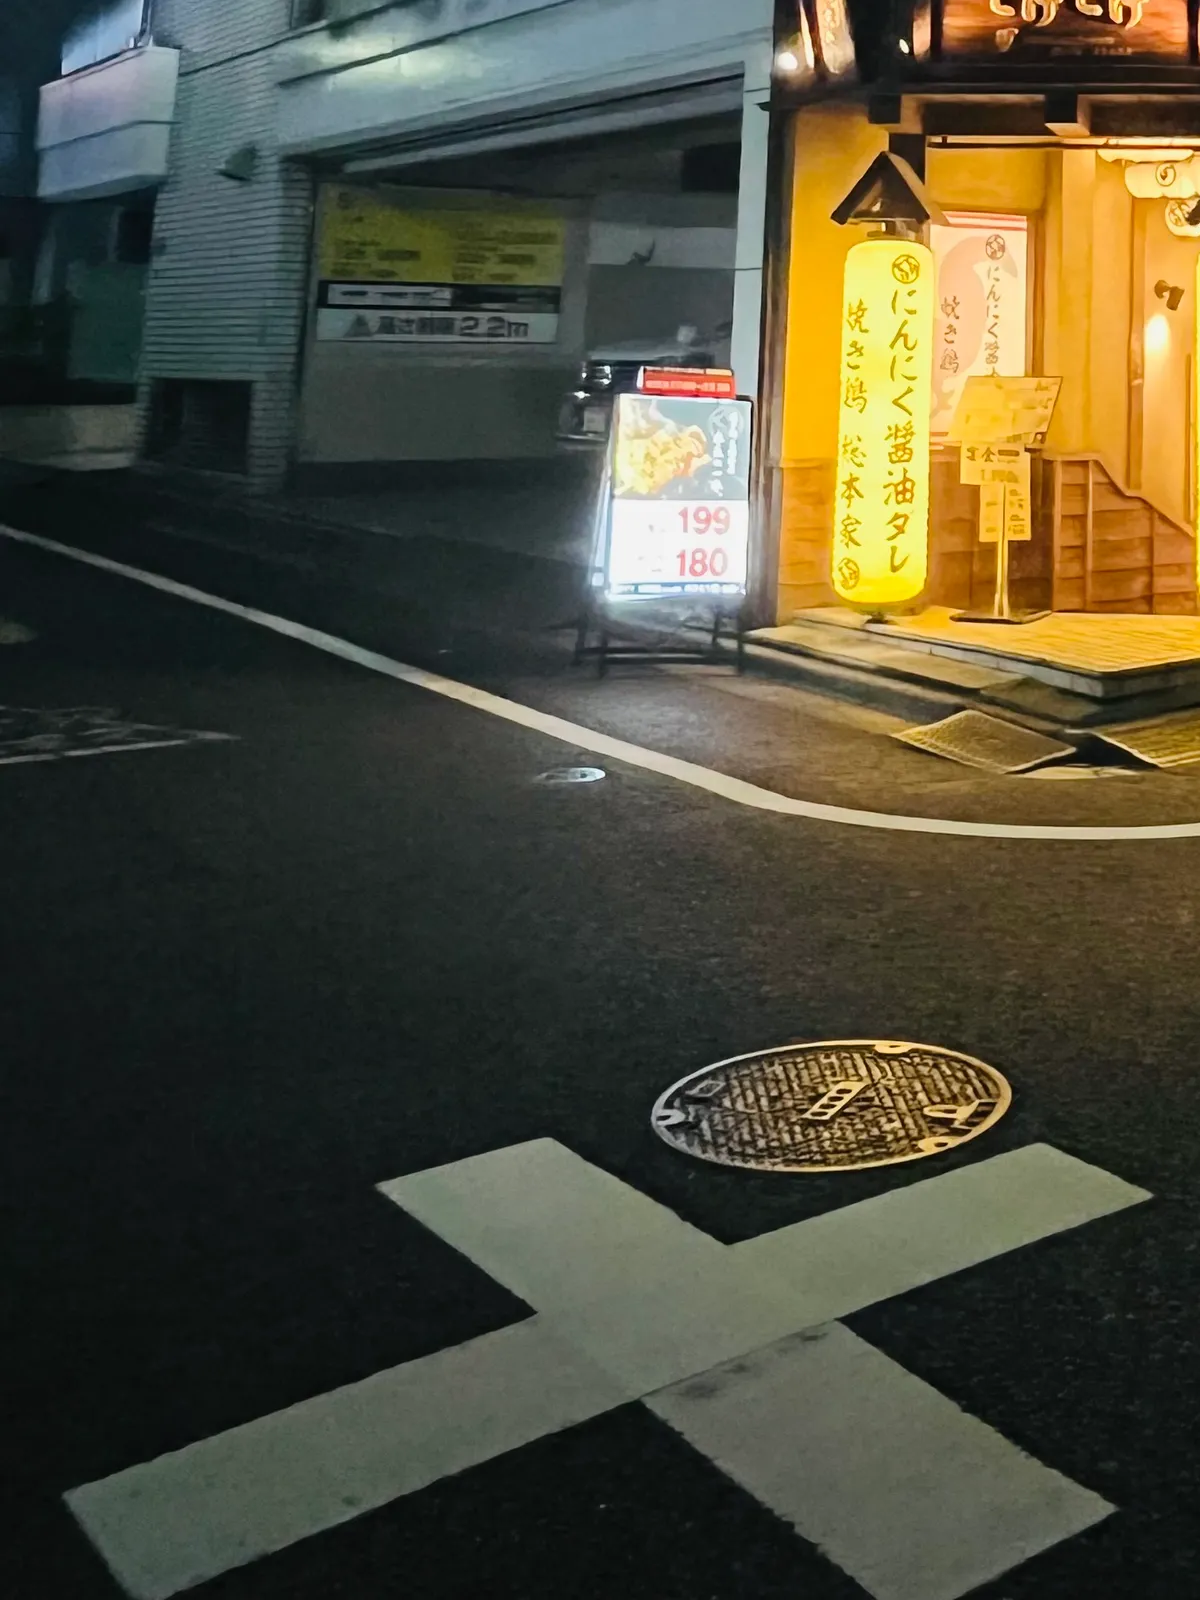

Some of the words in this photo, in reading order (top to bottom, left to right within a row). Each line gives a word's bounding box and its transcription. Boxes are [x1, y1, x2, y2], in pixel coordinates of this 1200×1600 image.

[984, 265, 1002, 377] にんにく醤
[677, 505, 731, 535] 199
[675, 547, 729, 578] 180
